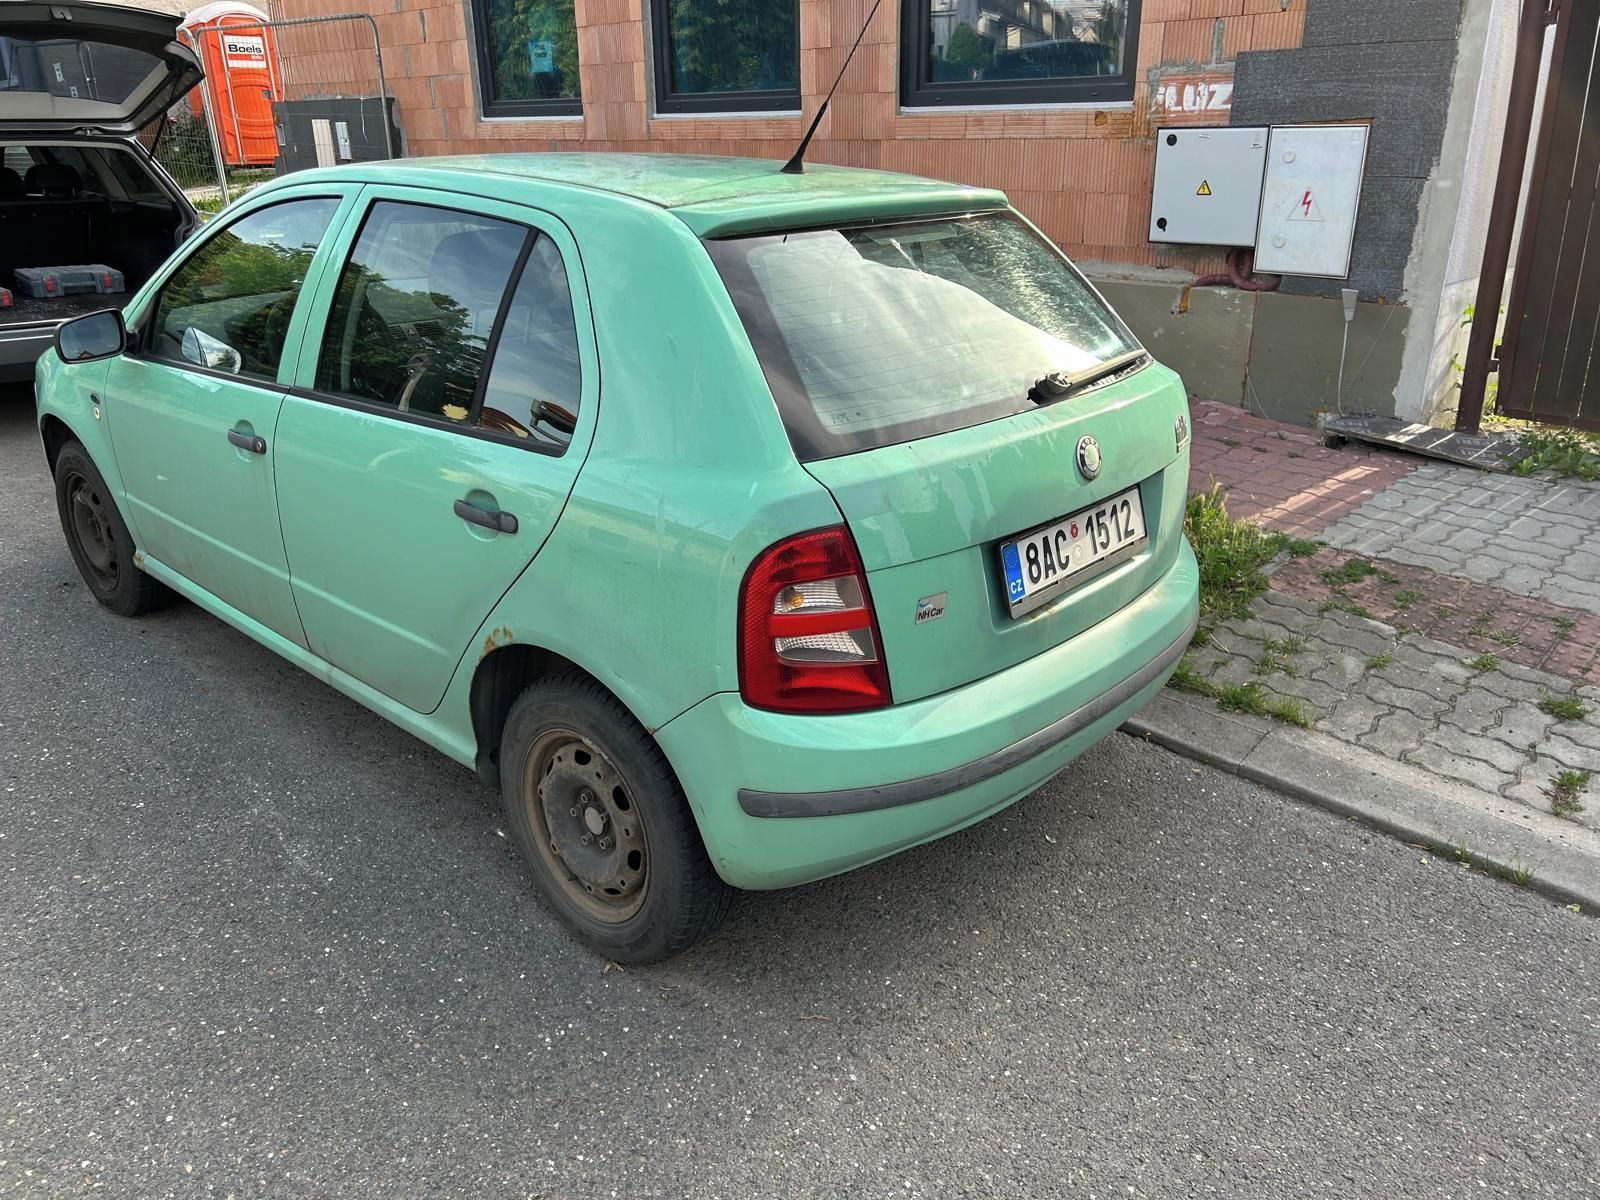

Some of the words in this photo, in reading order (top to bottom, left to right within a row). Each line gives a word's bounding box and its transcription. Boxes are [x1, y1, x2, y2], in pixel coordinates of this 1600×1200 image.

[228, 44, 262, 54] Boels
[1025, 529, 1070, 584] 8AC
[1085, 499, 1135, 556] 1512
[1010, 578, 1023, 594] CZ
